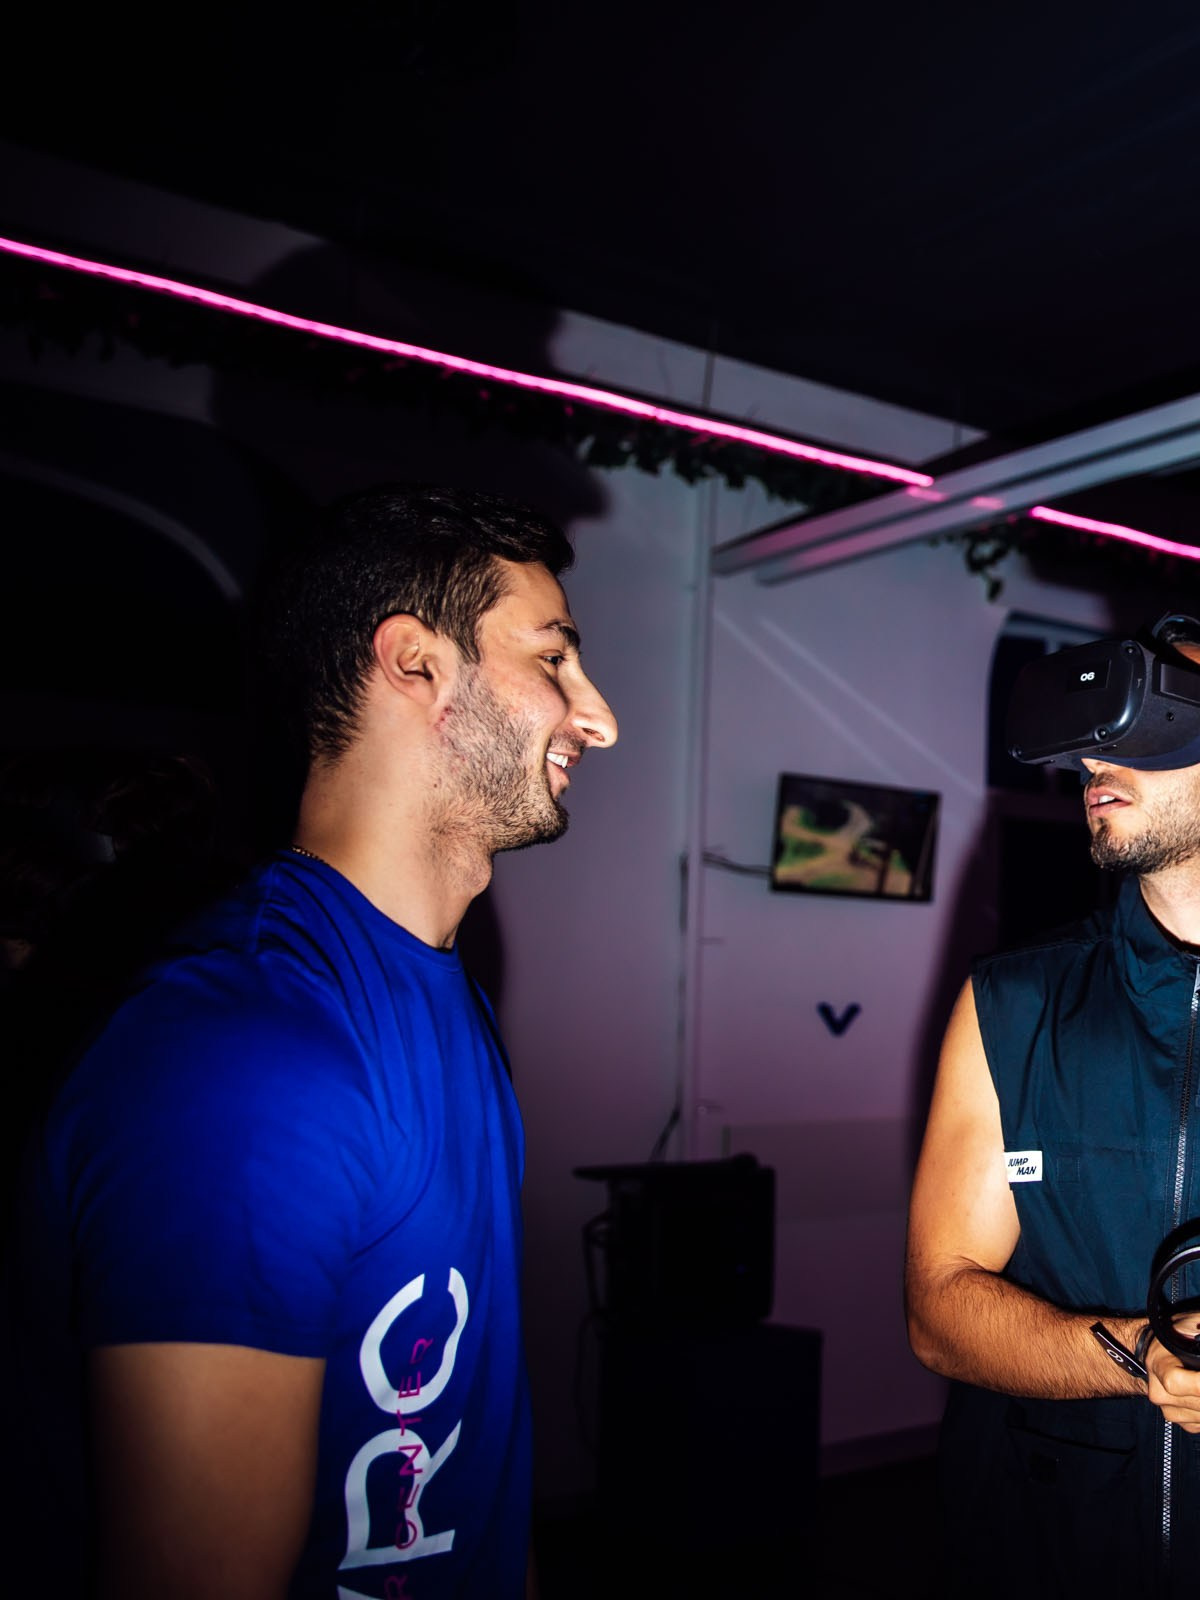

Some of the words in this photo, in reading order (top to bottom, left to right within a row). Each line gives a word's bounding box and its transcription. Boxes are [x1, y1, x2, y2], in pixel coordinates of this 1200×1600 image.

[1008, 1157, 1029, 1167] JUMP
[1016, 1166, 1037, 1175] MAN
[337, 1266, 469, 1600] RC
